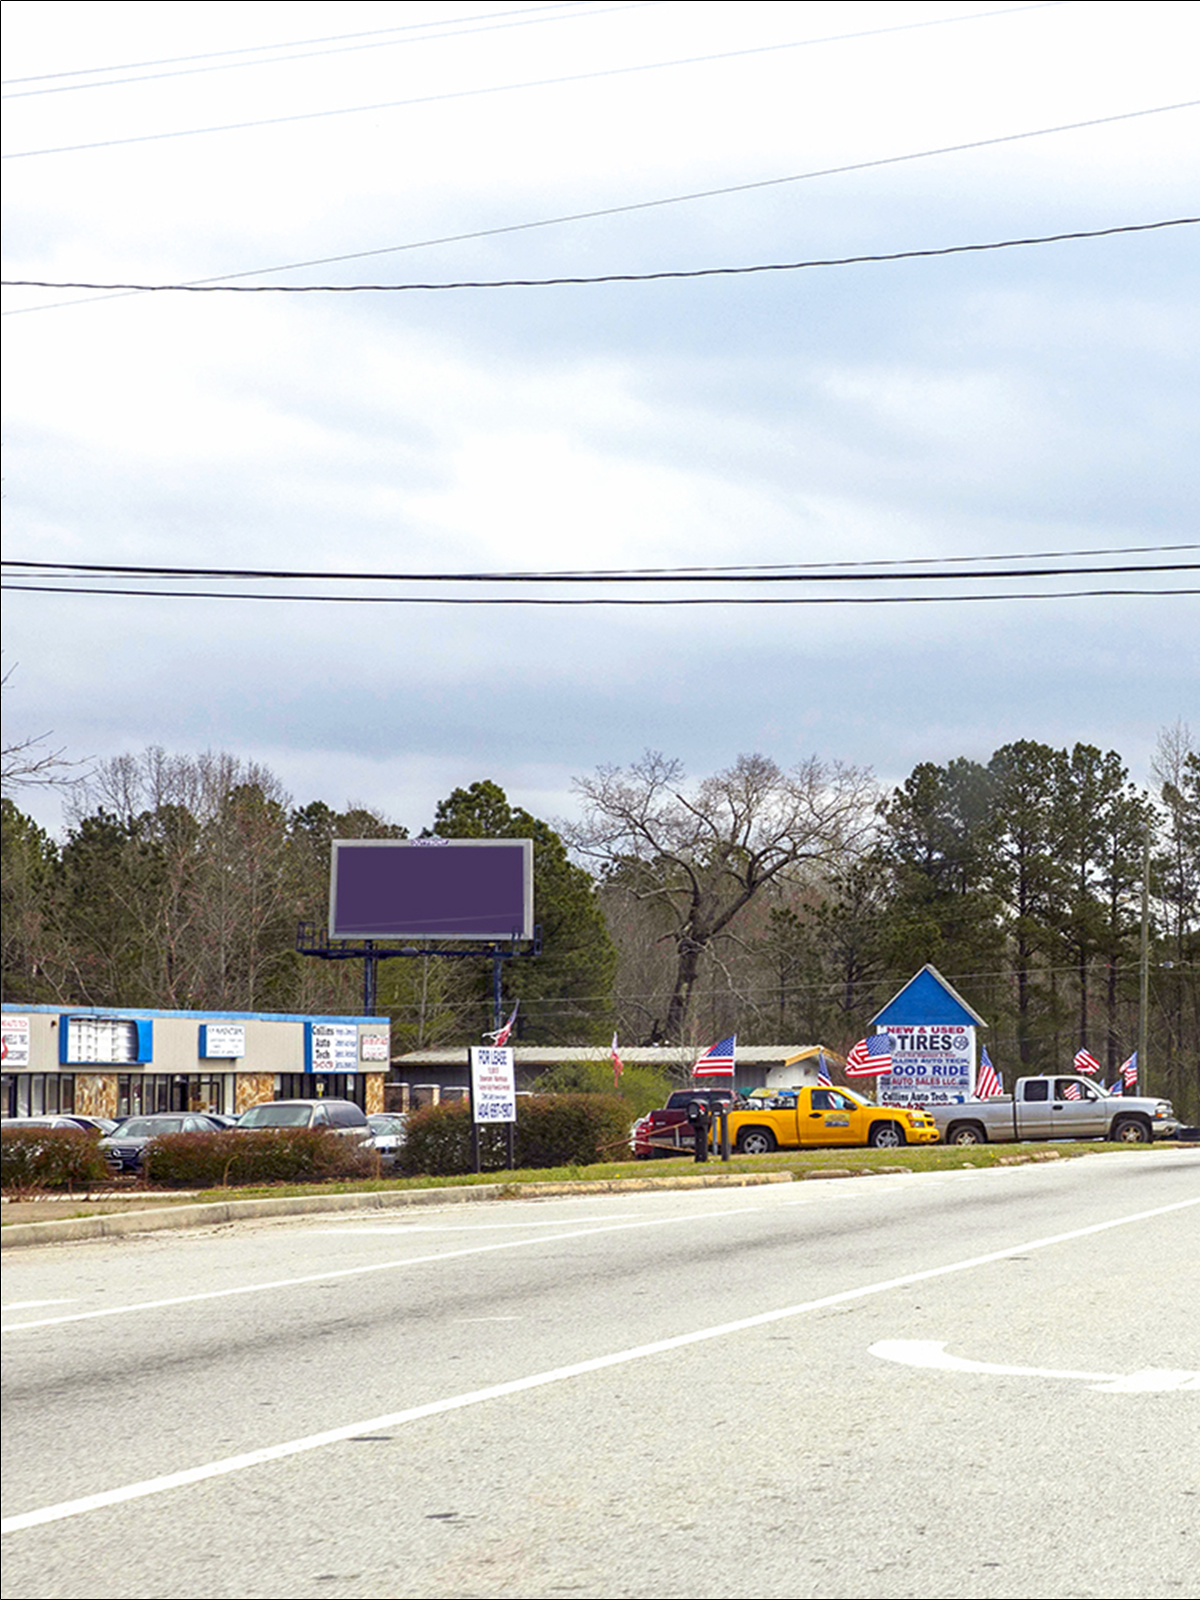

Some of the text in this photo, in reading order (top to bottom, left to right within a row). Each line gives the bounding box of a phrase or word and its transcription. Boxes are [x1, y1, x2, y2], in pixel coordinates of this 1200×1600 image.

[887, 1026, 914, 1034] NEW
[897, 1035, 952, 1051] TIRES
[889, 1065, 969, 1076] OOD RIDE
[891, 1077, 914, 1086] AUTO
[915, 1077, 940, 1086] SALES
[882, 1092, 949, 1101] Collins Auto Tech
